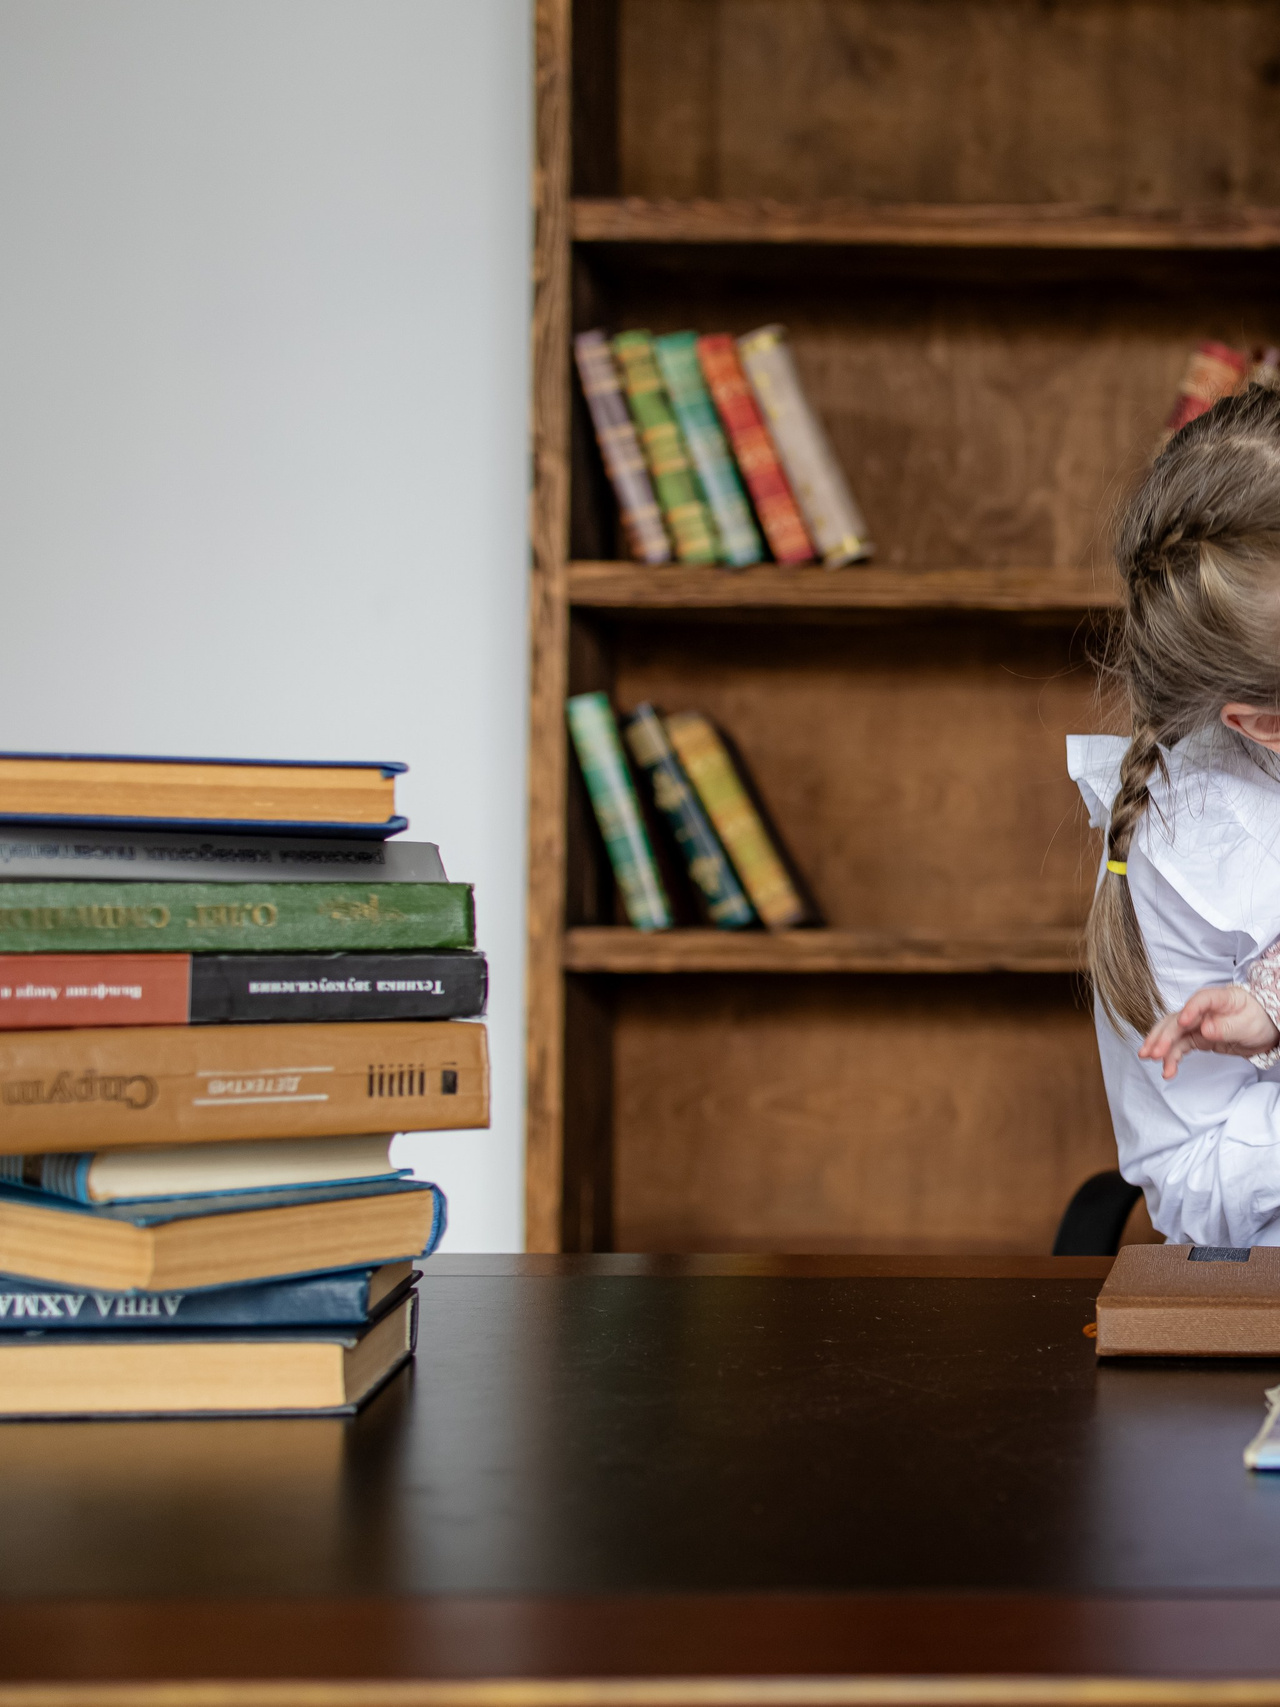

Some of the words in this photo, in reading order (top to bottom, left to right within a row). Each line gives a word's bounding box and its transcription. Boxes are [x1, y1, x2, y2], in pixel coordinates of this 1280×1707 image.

[249, 977, 372, 995] звукоусиления
[376, 979, 445, 995] Техника
[207, 1076, 302, 1095] ДЕТЕКТИВ
[92, 1294, 186, 1317] АННА
